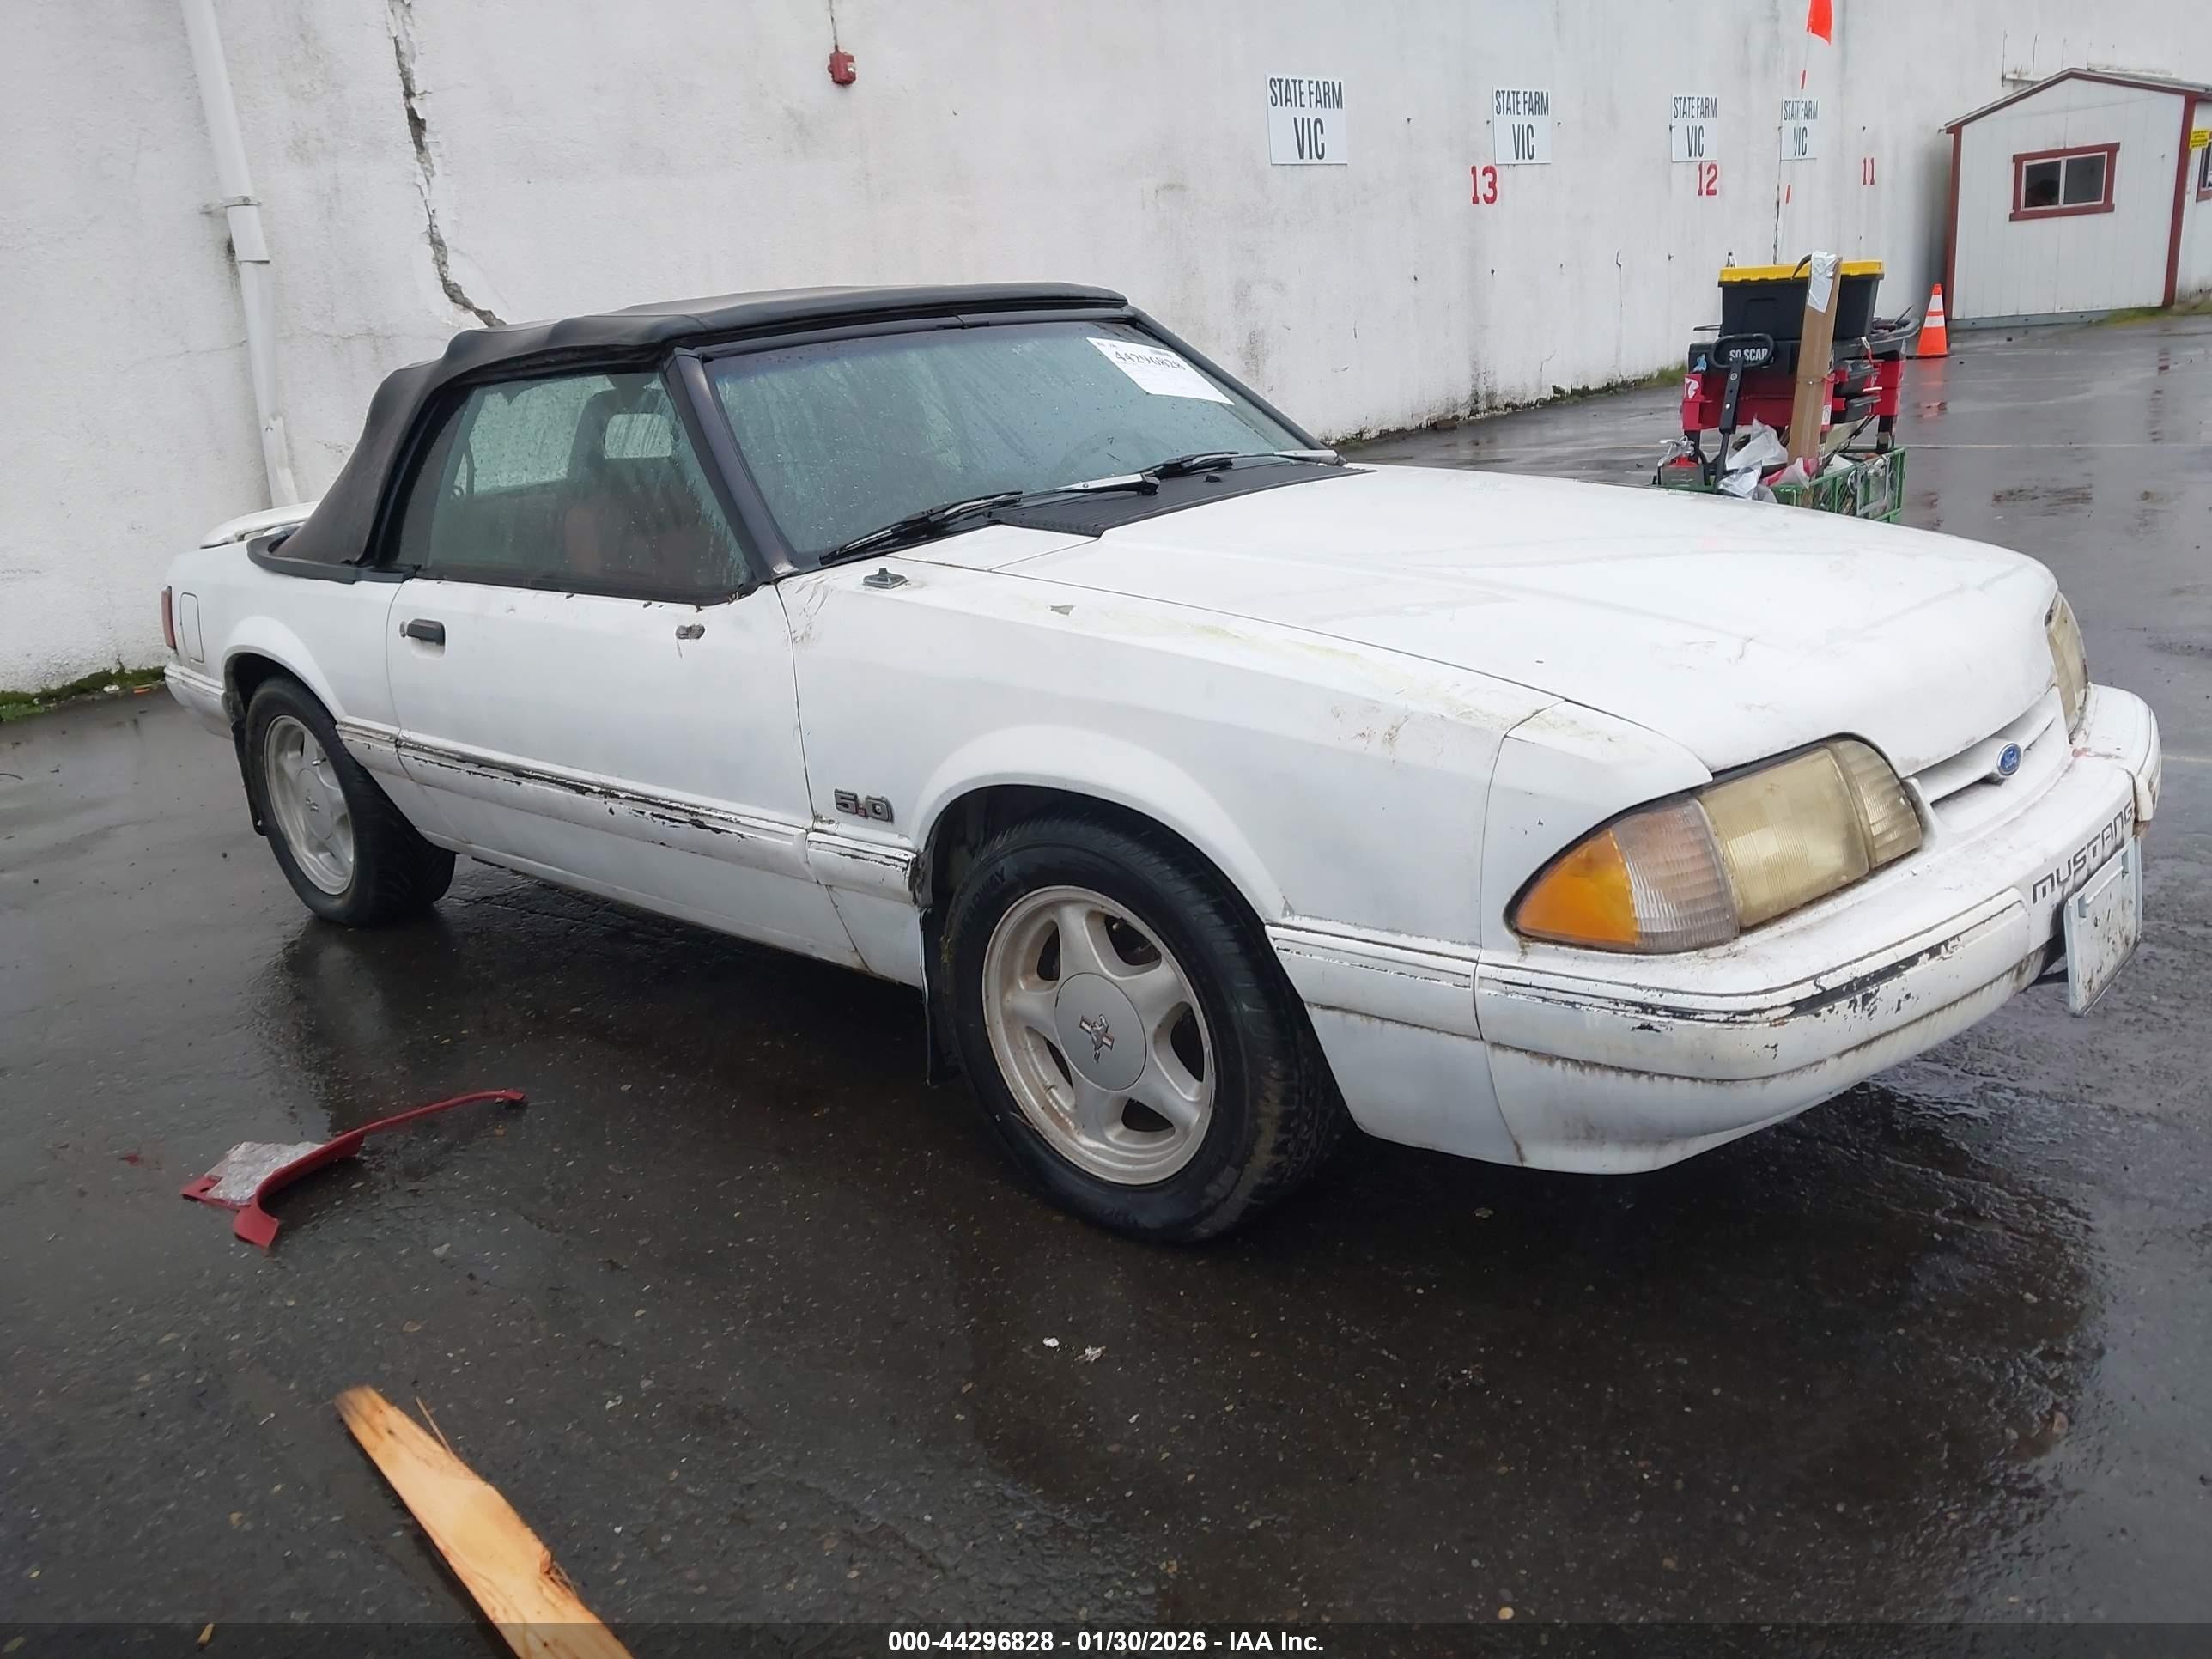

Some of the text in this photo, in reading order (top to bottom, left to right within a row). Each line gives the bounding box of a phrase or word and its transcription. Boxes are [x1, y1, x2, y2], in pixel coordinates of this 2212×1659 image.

[1269, 77, 1344, 110] STATE FARM
[1495, 89, 1549, 117] STATE FARM
[1674, 97, 1717, 118] STATE FARM
[1801, 100, 1819, 120] FARM
[1293, 117, 1326, 161] VIC
[1511, 123, 1535, 161] VIC
[1686, 125, 1704, 157] VIC
[1793, 126, 1808, 156] VIC
[1470, 166, 1498, 205] 13
[1698, 161, 1718, 196] 12
[1863, 157, 1875, 185] 11
[2032, 799, 2133, 905] MUSTANG
